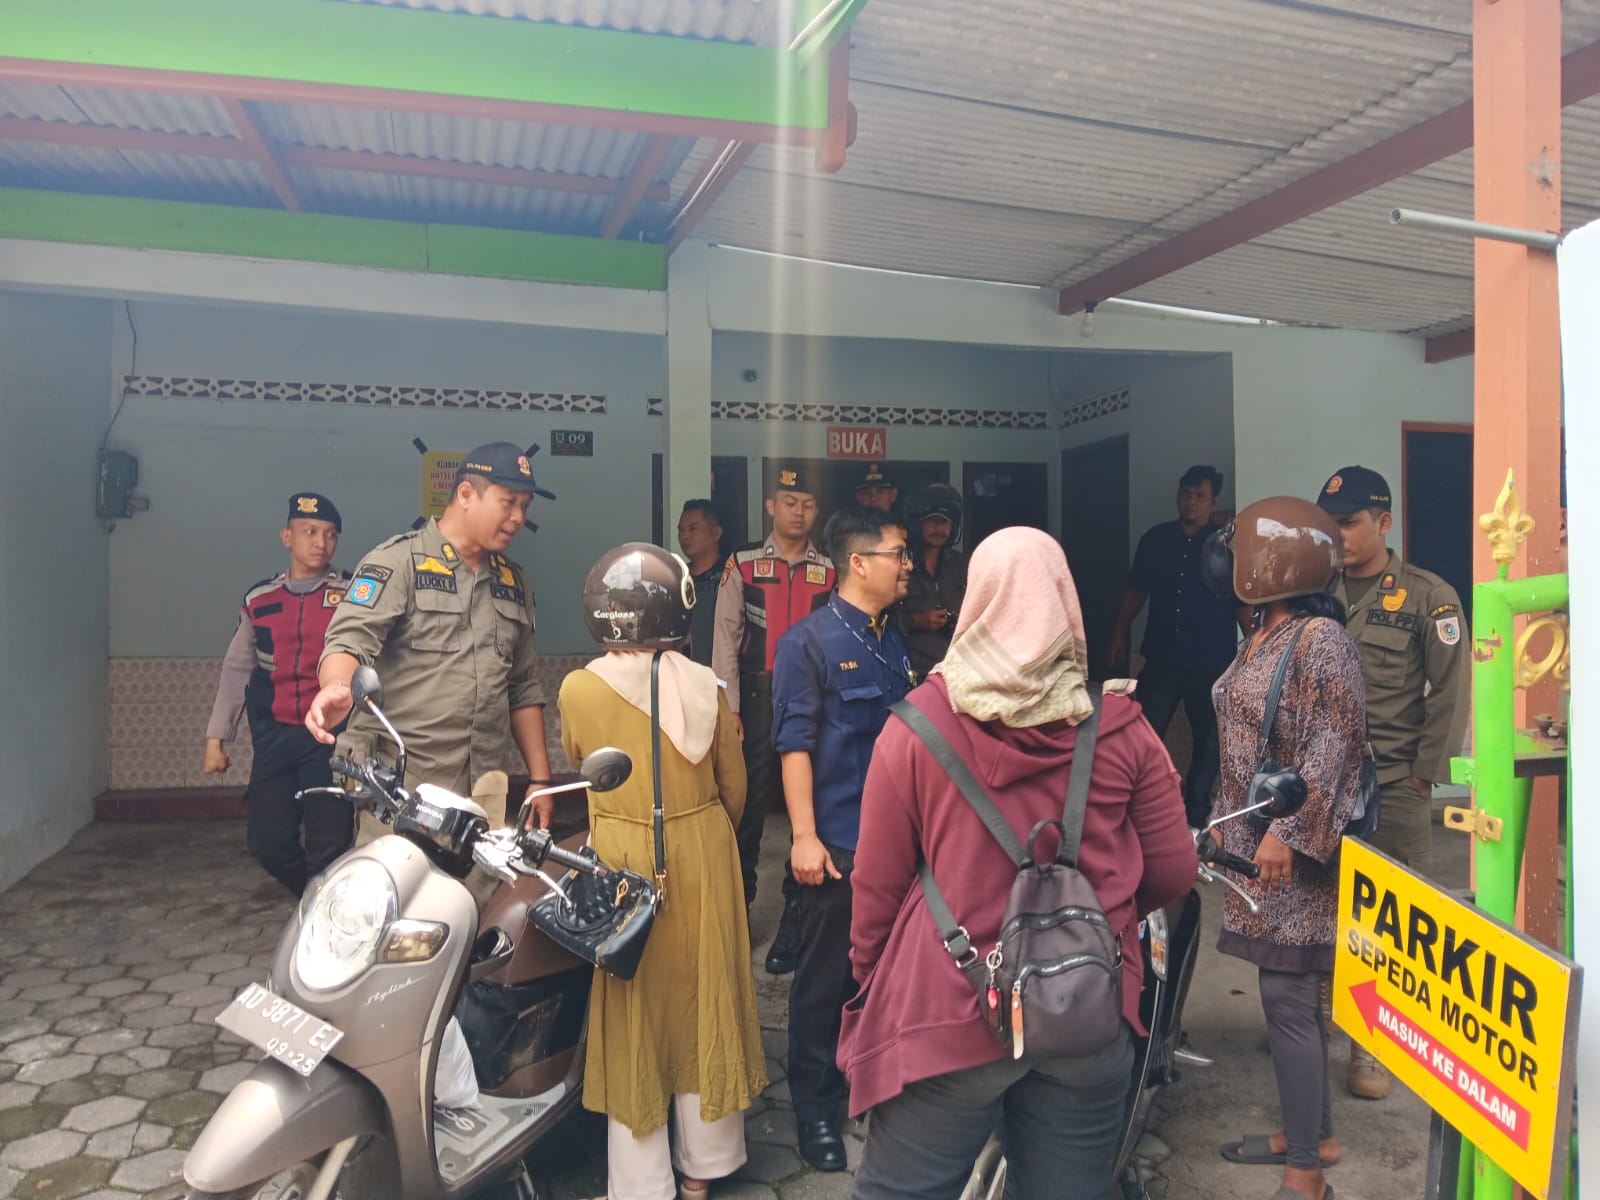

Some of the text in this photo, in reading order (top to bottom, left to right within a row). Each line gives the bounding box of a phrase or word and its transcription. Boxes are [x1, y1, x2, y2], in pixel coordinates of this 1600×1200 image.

[568, 433, 586, 444] 09
[828, 431, 884, 454] BUKA
[1370, 610, 1414, 628] POL PP
[416, 803, 444, 822] HONDA
[1351, 868, 1539, 1046] PARKIR
[236, 983, 343, 1052] AD 3871 EJ
[1347, 929, 1539, 1092] SEPEDA MOTOR
[1378, 1004, 1517, 1132] MASUK KE DALAM
